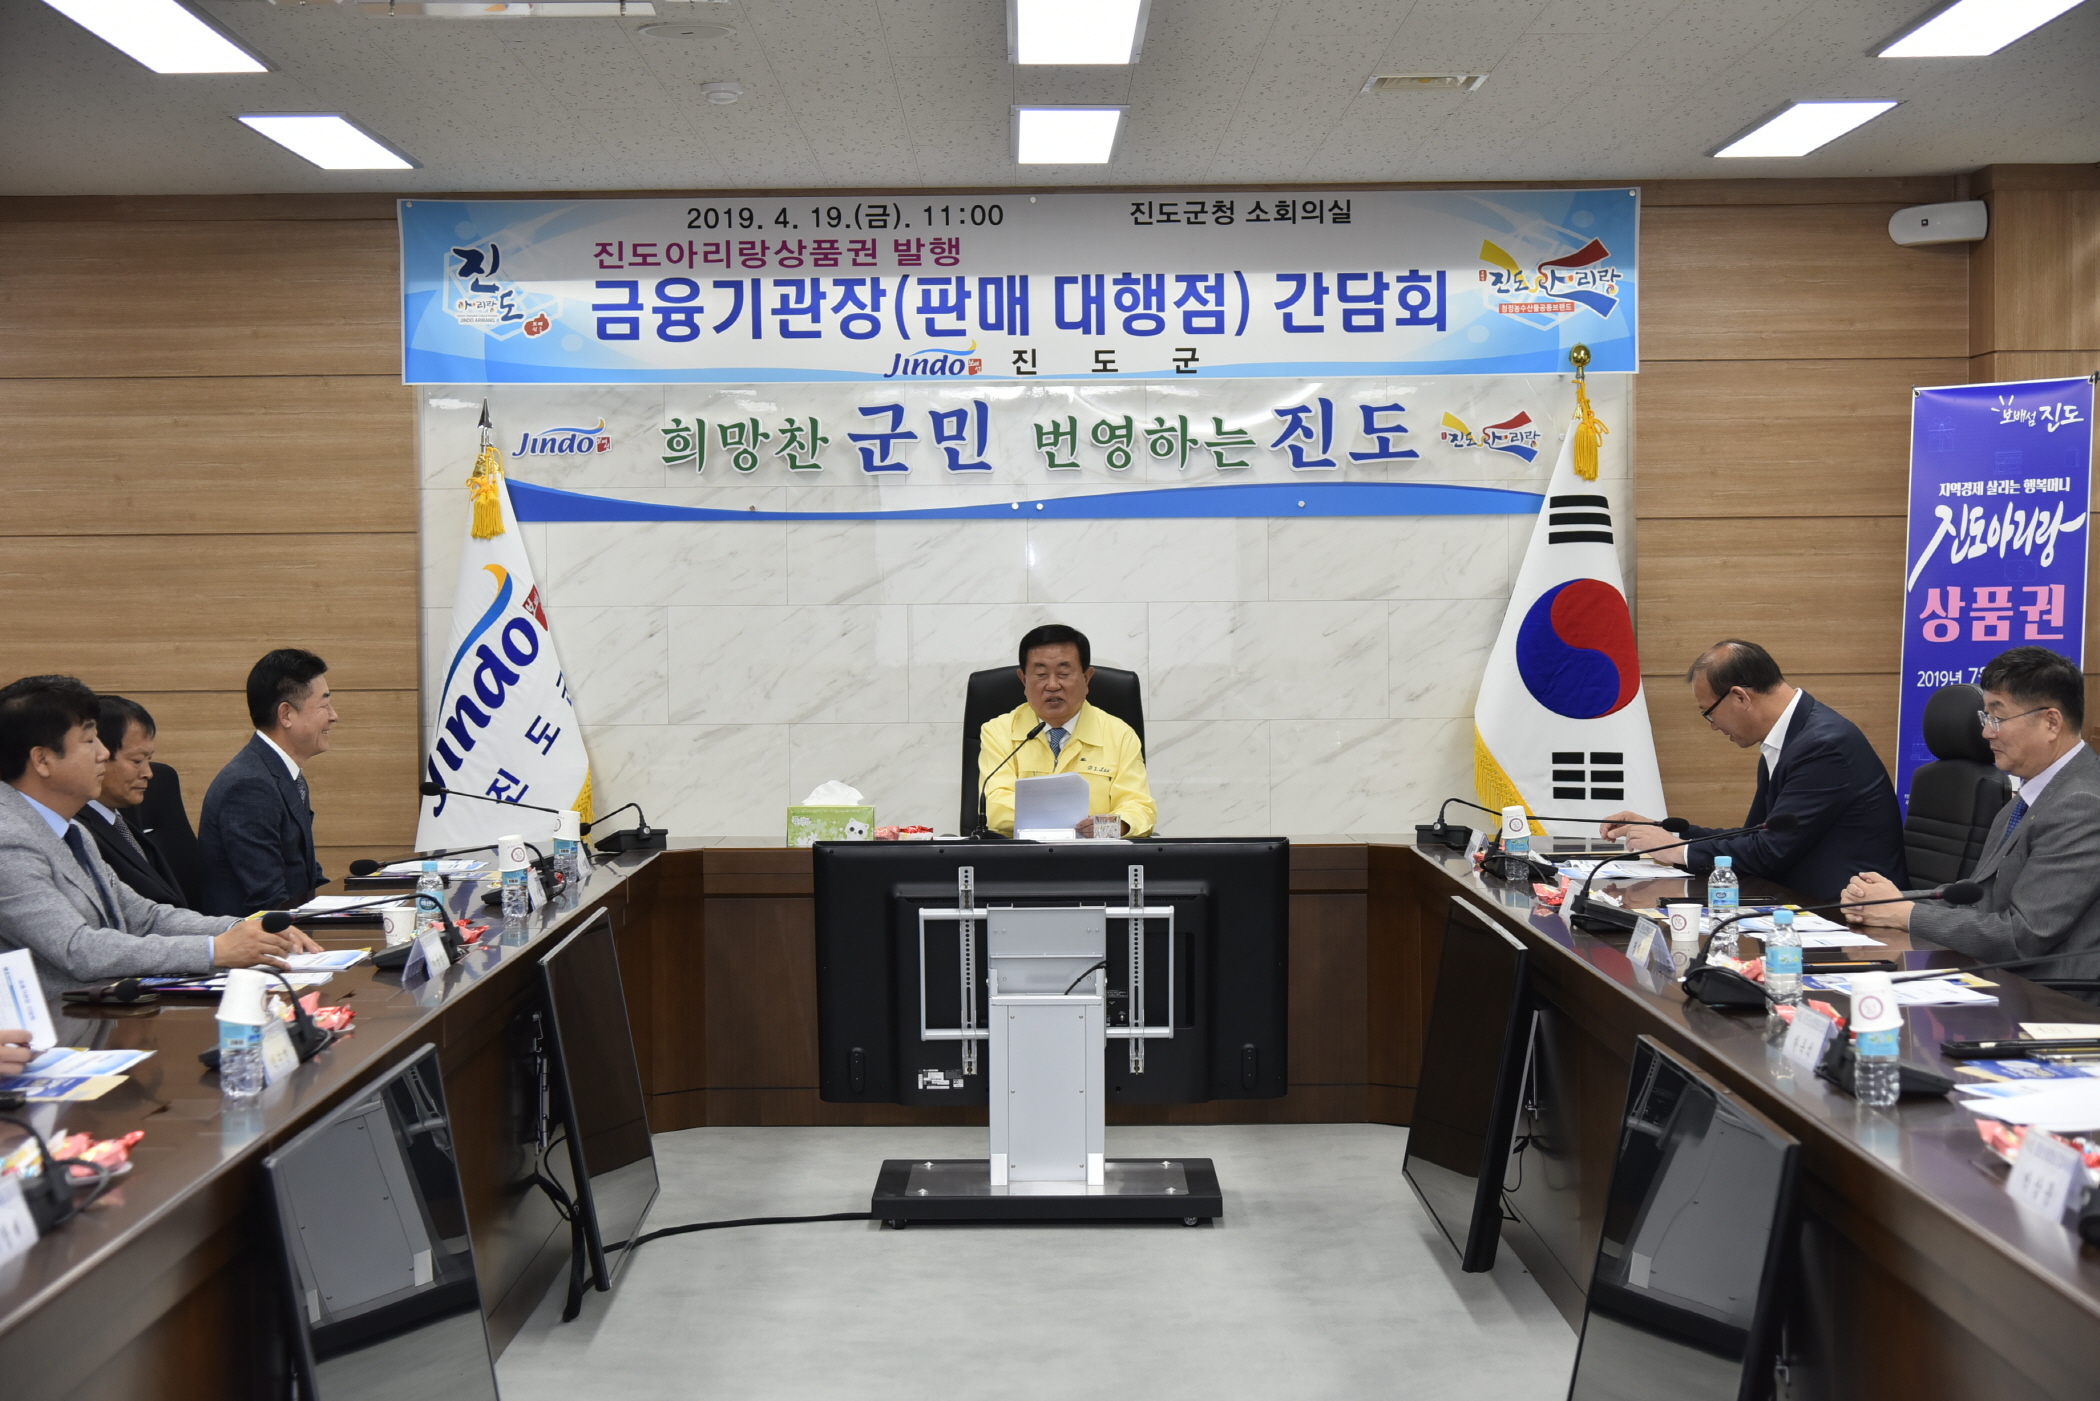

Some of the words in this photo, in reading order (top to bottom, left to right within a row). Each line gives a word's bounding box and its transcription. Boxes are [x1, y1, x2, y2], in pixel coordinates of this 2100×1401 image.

[687, 207, 763, 230] 2019.
[774, 207, 798, 230] 4.
[923, 204, 1004, 227] 11:00
[1130, 200, 1235, 226] 진도군청
[1245, 199, 1352, 225] 소회의실
[593, 239, 878, 270] 진도아리랑상품권
[893, 237, 961, 268] 발행
[1489, 269, 1530, 294] 진도
[592, 273, 1029, 343] 금융기관장(판매
[1055, 271, 1250, 337] 대행점)
[1274, 270, 1447, 334] 간담회
[883, 353, 966, 378] Jindo
[2000, 408, 2037, 427] 보배섬
[2039, 402, 2084, 432] 진도
[511, 433, 595, 457] Jindo
[662, 417, 830, 472] 희망찬
[848, 400, 993, 473] 군민
[1035, 414, 1257, 470] 번영하는
[1271, 397, 1420, 470] 진도
[1938, 480, 1984, 497] 지역경제
[1986, 479, 2021, 495] 살리는
[2023, 477, 2071, 494] 행복머니
[1908, 500, 2087, 593] 진도아리랑
[1919, 584, 2066, 643] 상품권
[1917, 670, 1962, 687] 2019년
